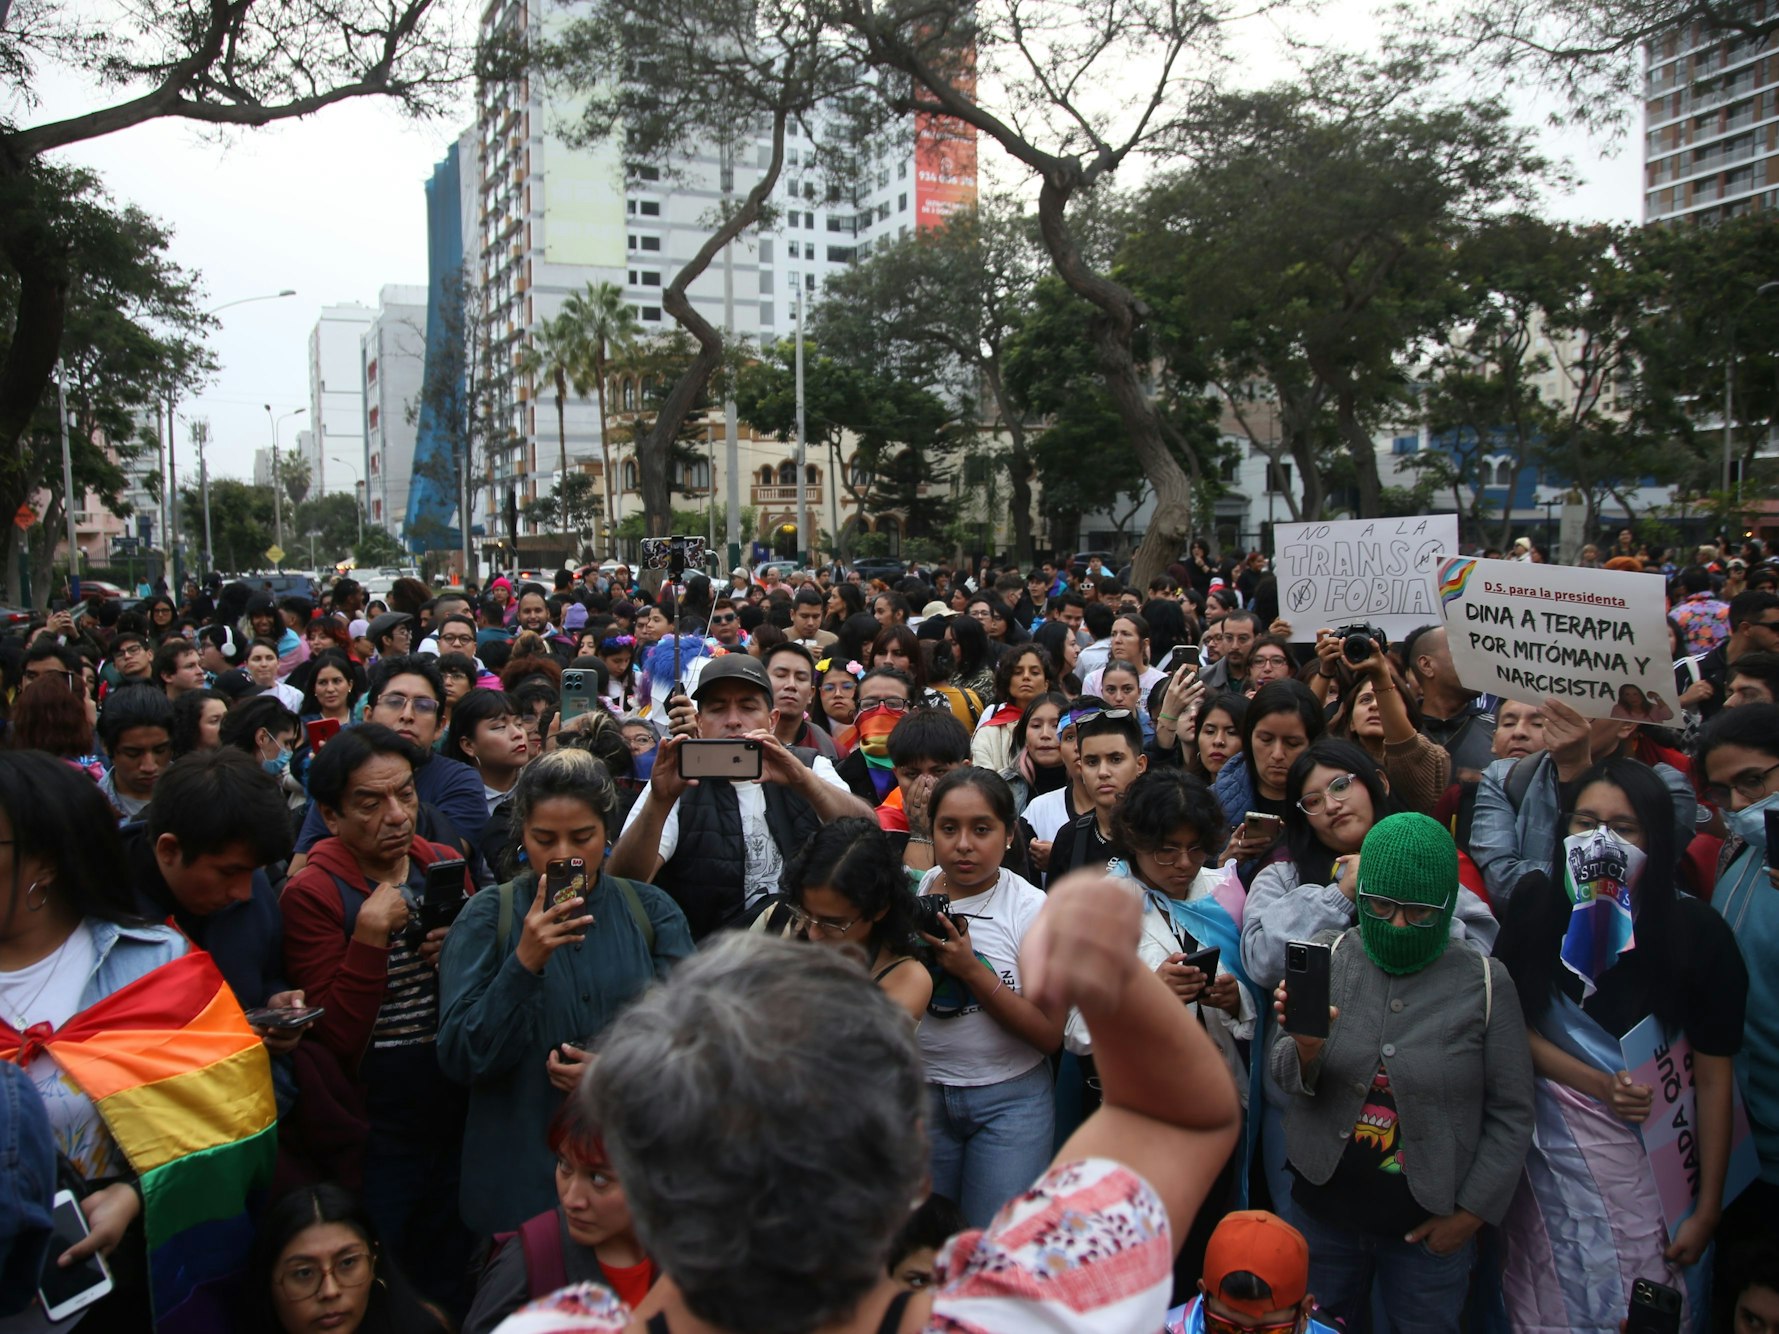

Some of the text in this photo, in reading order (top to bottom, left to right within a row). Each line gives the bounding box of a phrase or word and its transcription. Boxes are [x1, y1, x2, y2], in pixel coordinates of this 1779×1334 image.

[1297, 525, 1330, 541] NO
[1361, 523, 1375, 537] A
[1283, 539, 1410, 577] TRANS
[1324, 577, 1432, 614] FOBIA
[1484, 581, 1626, 607] D.S. para la presidenta
[1466, 602, 1634, 645] DINA A TERAPIA
[1469, 631, 1652, 676] POR MITÓMANA Y
[1496, 664, 1616, 702] NARCISISTA
[1653, 1043, 1683, 1104] QUE
